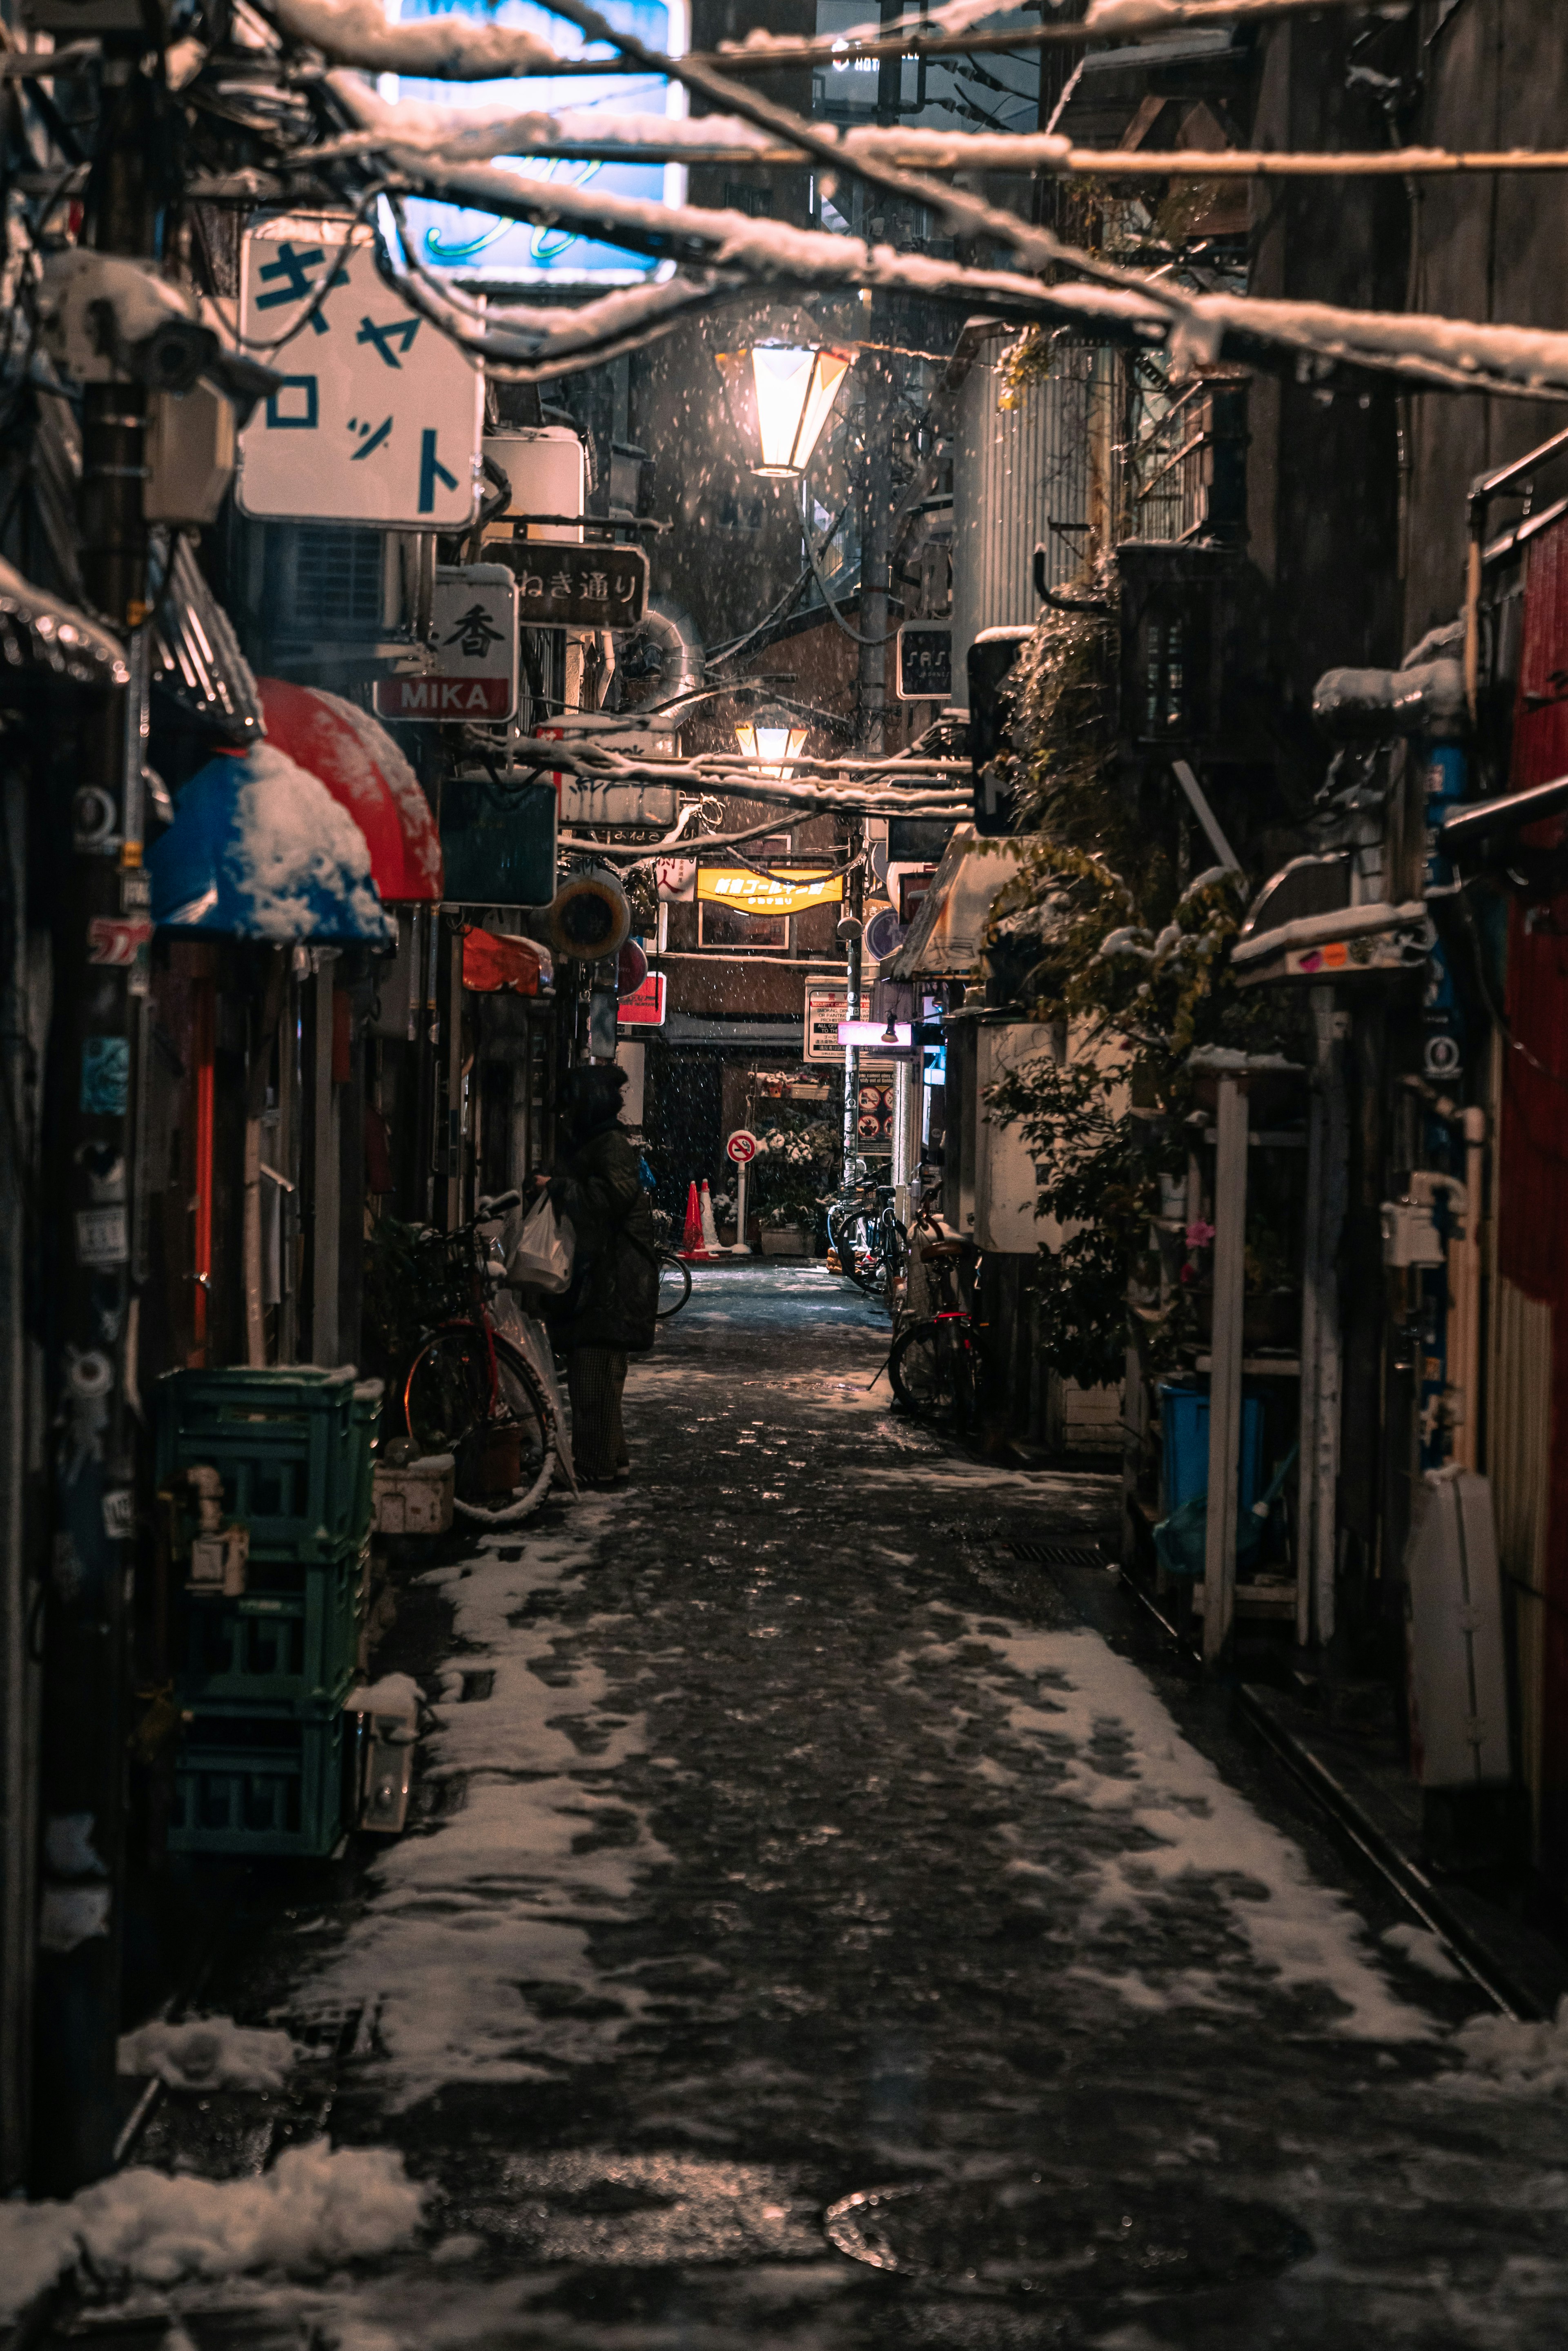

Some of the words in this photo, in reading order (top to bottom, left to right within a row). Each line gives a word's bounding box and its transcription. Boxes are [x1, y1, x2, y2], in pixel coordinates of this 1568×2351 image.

[519, 571, 635, 603] ねき通り
[429, 604, 505, 657] 香
[401, 683, 489, 710] MIKA
